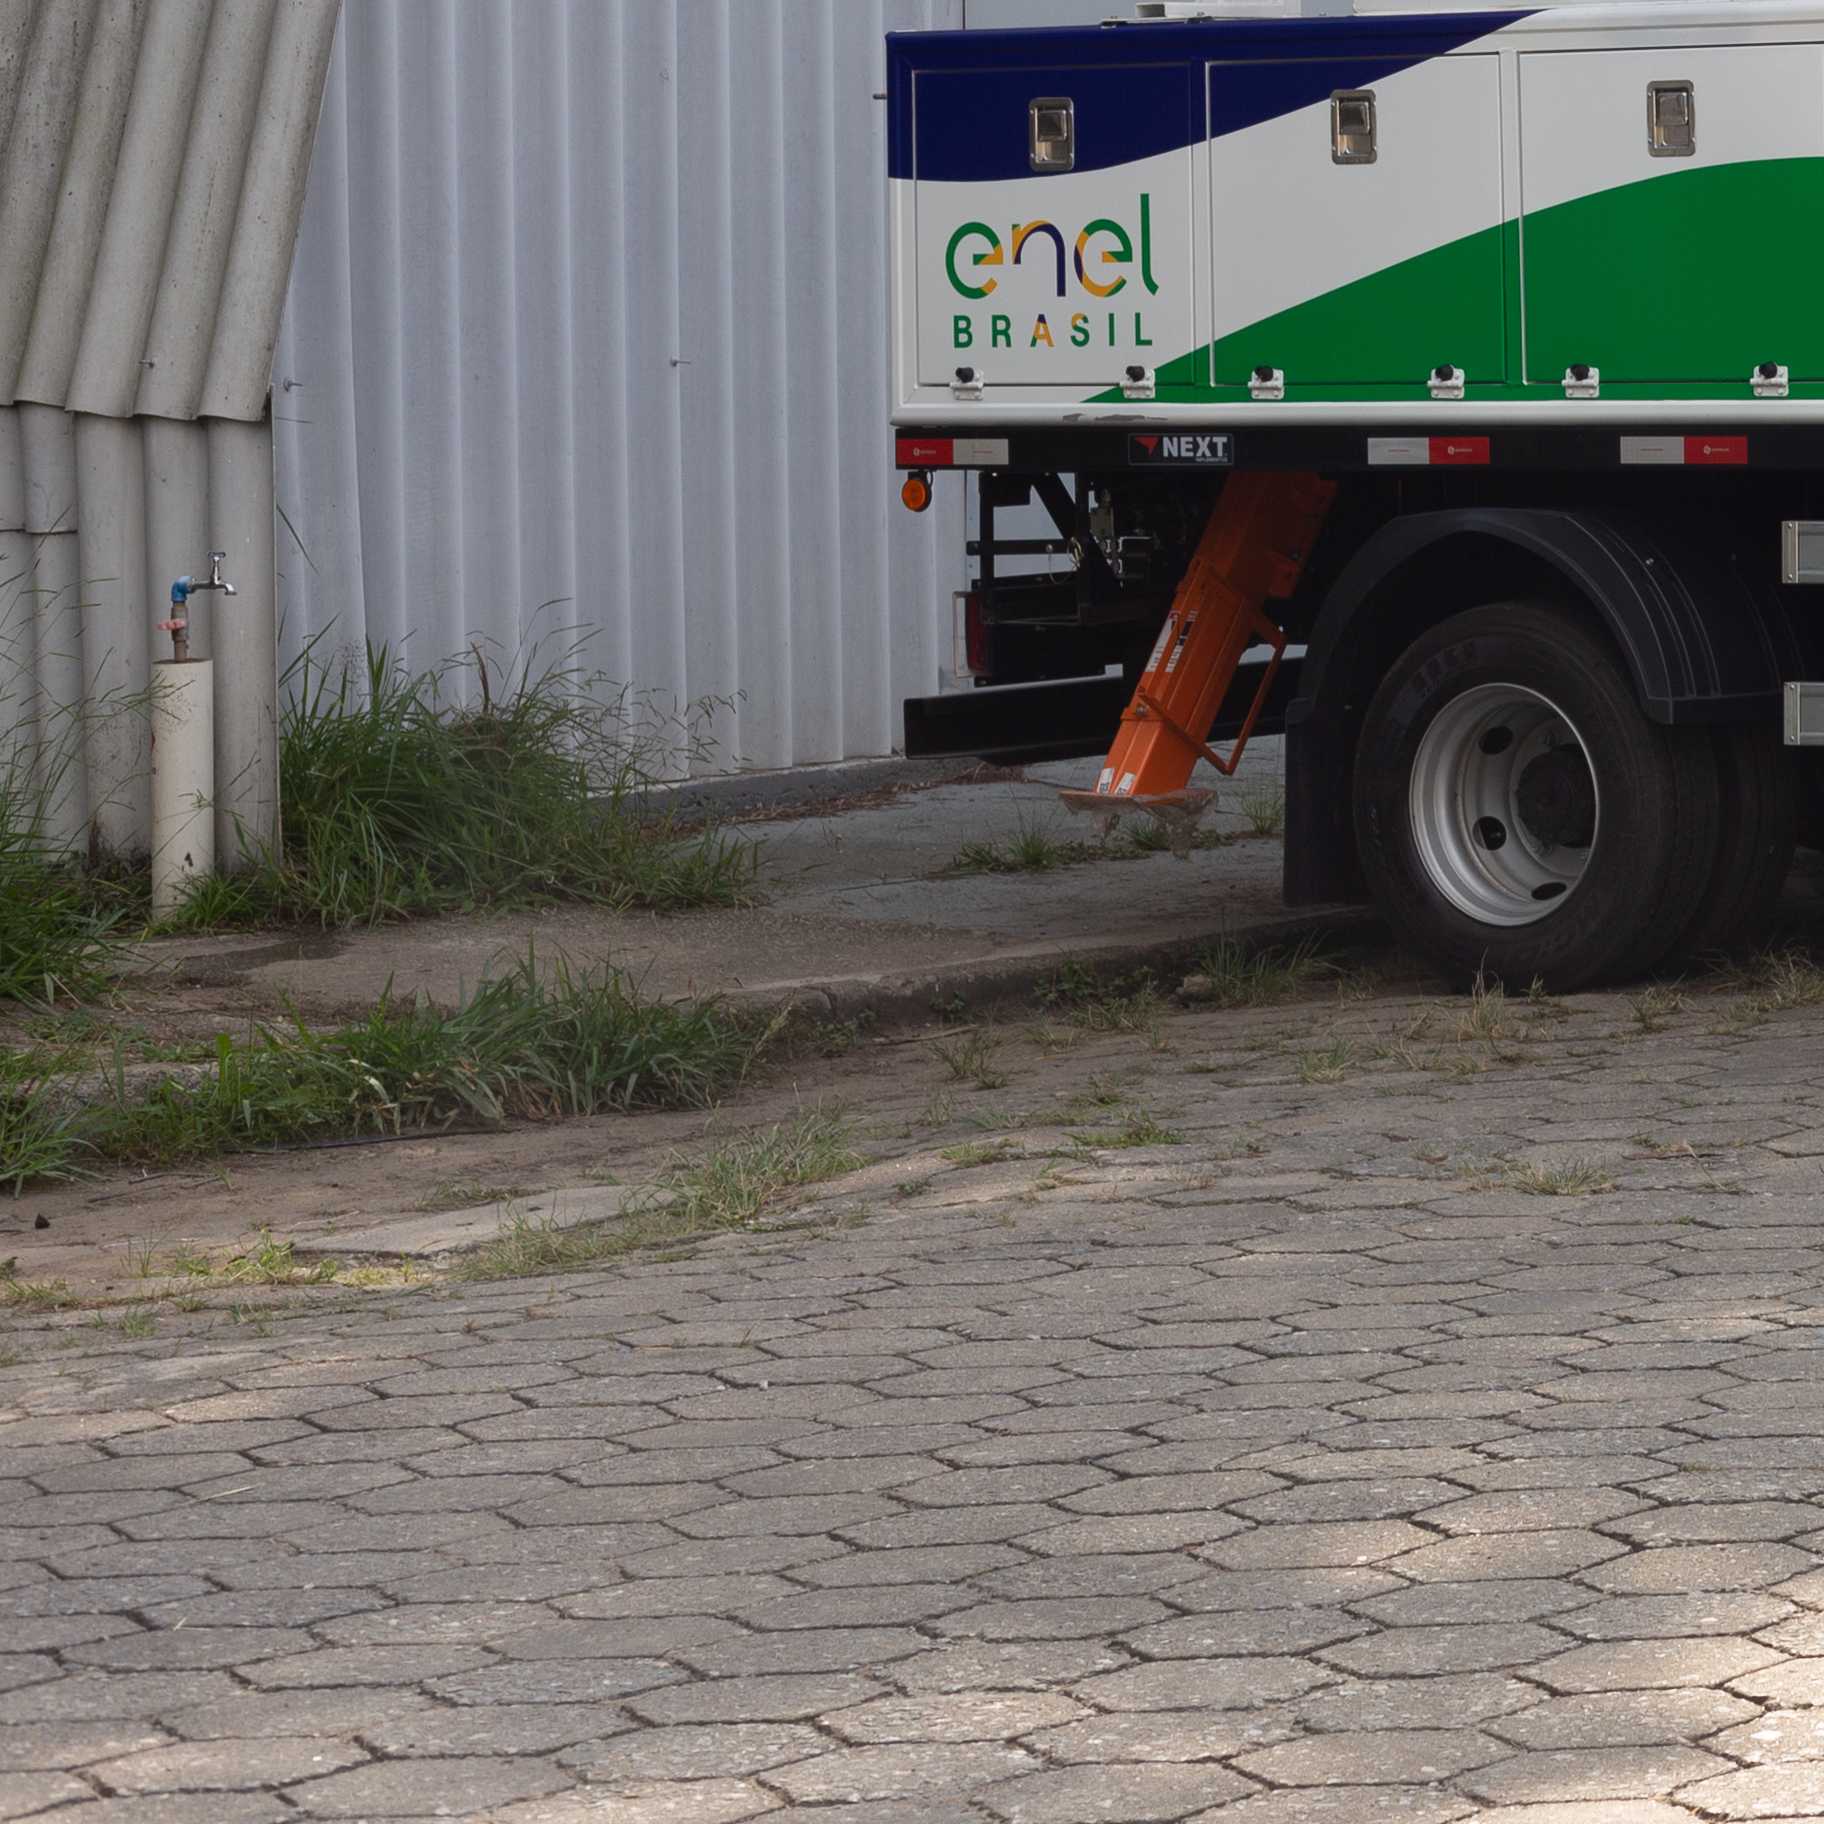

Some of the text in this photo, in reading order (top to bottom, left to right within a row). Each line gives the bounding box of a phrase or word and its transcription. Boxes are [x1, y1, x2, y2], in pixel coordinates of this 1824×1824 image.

[945, 193, 1159, 299] enel
[953, 312, 1153, 349] BRASIL
[1162, 436, 1228, 457] NEXT
